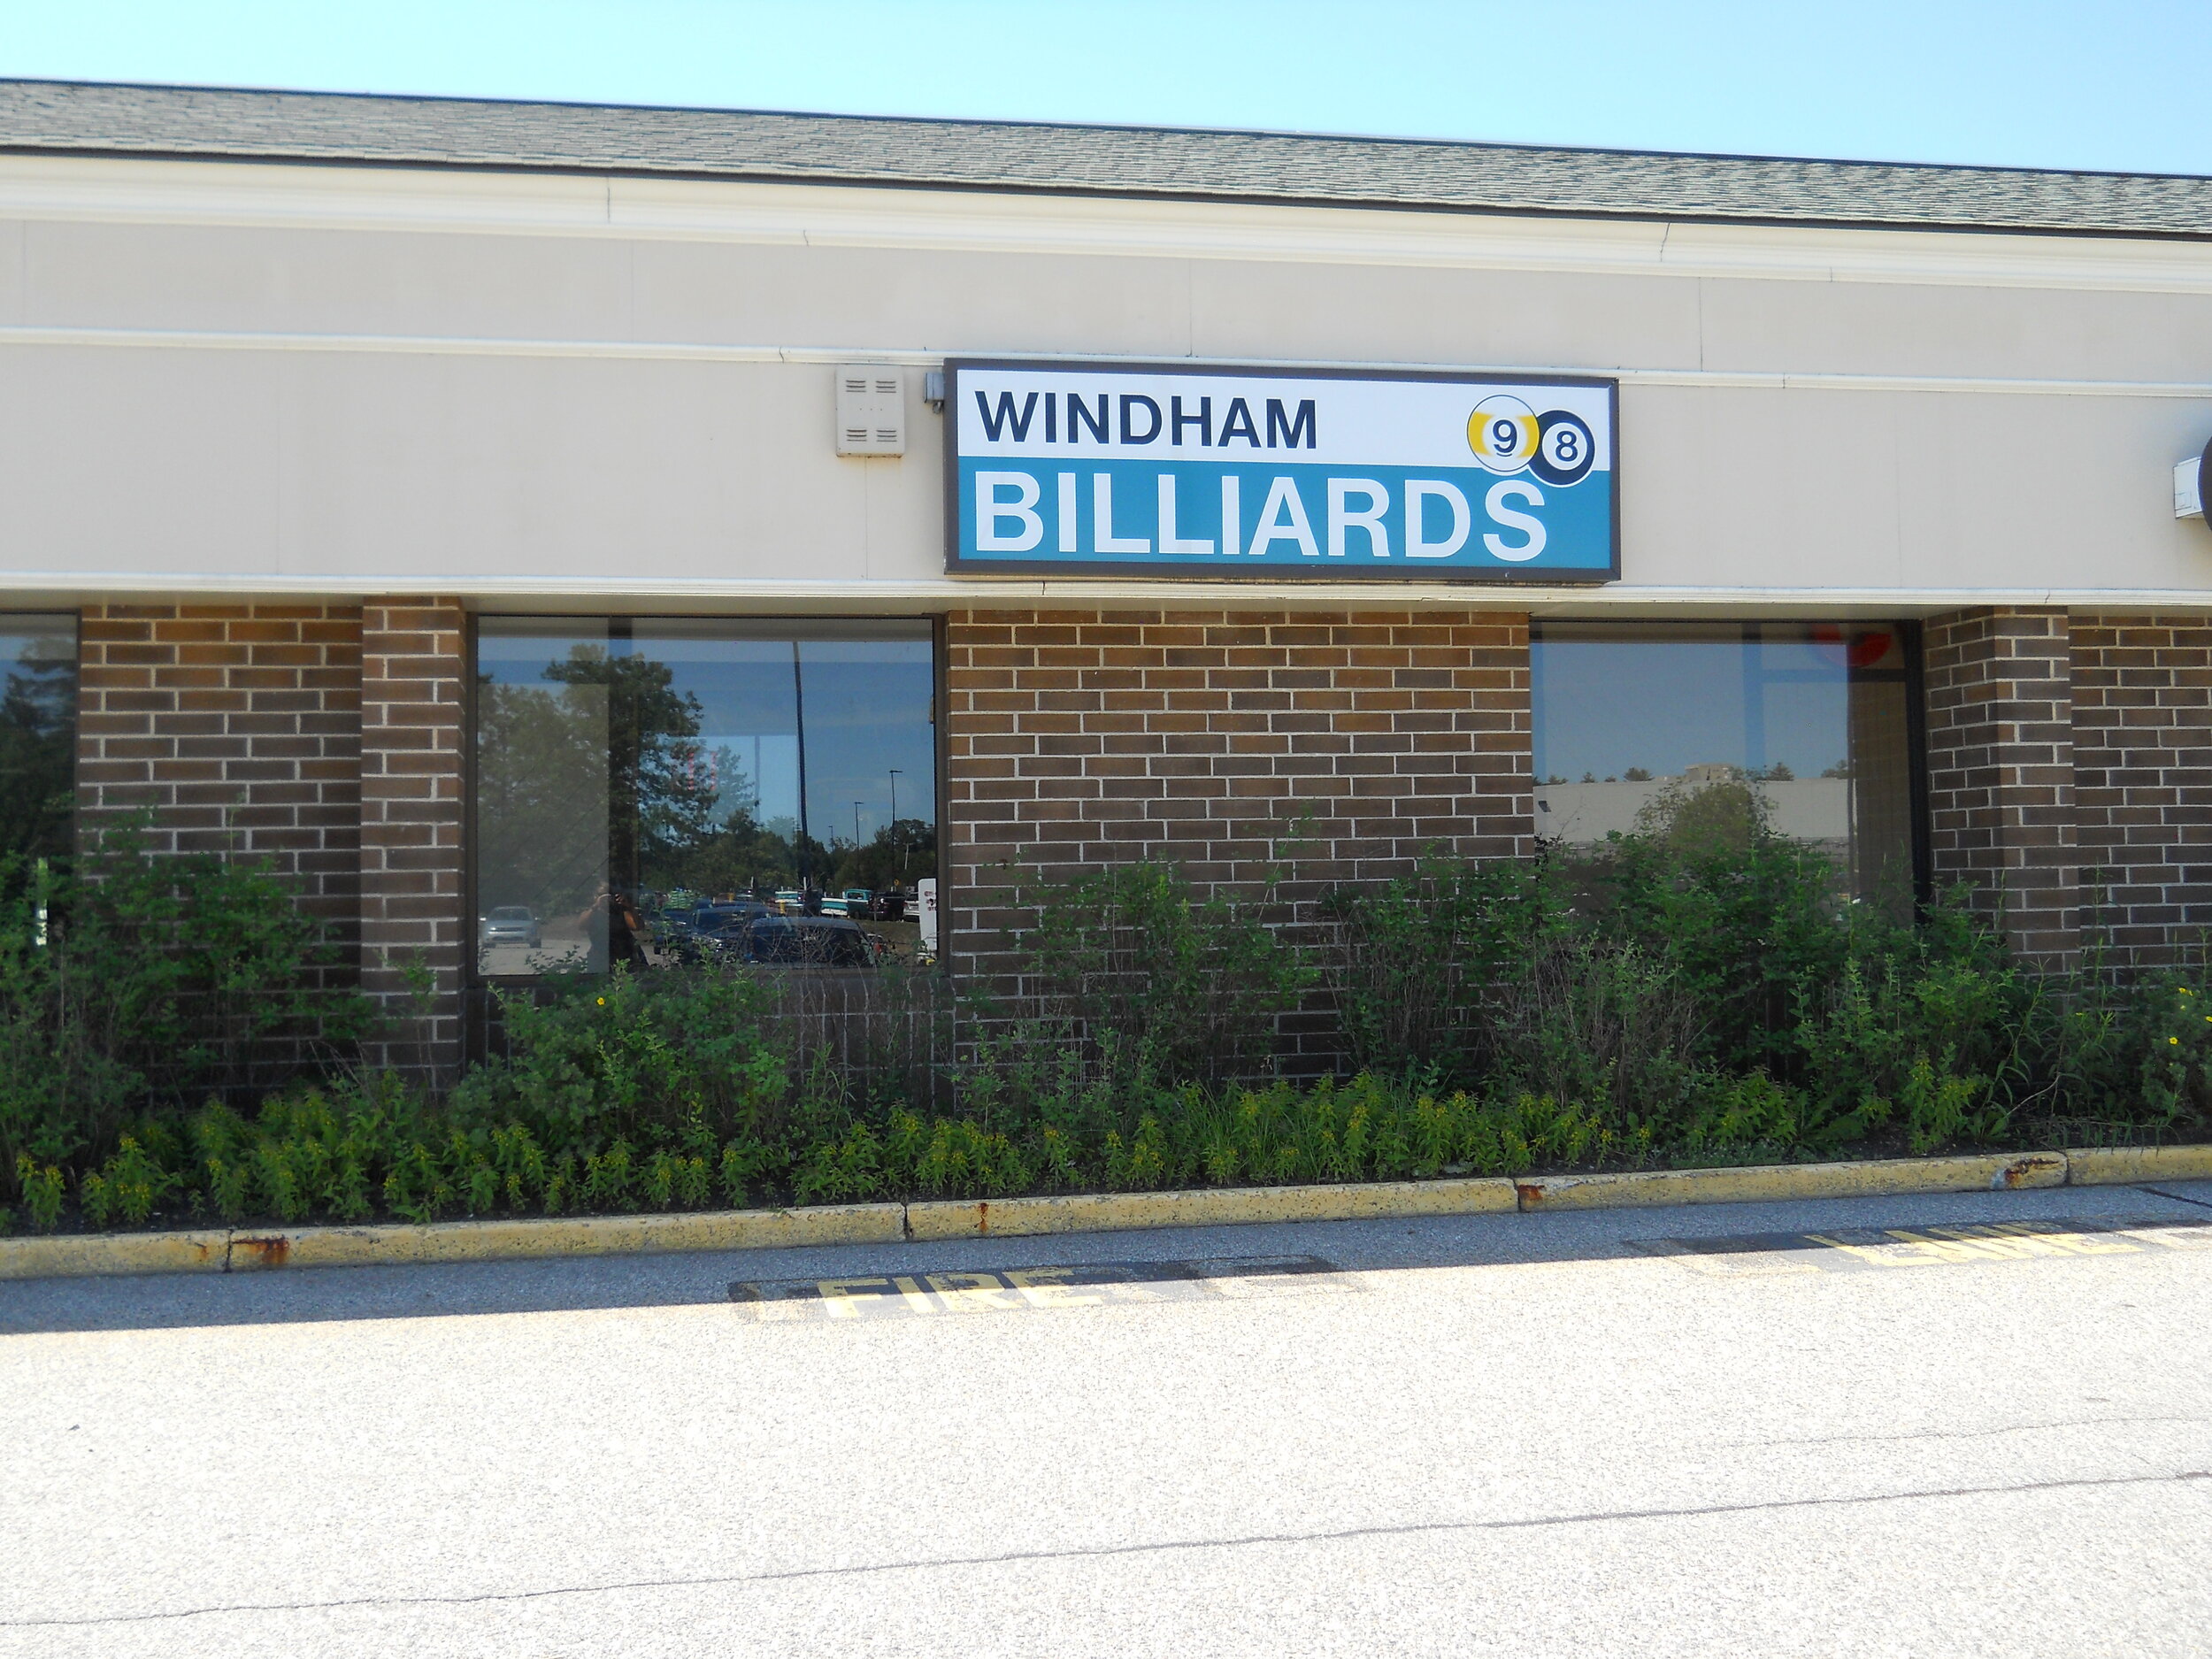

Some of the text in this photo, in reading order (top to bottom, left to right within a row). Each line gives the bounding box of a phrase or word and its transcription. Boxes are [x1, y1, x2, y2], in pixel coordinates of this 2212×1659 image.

[974, 390, 1317, 450] WINDHAM
[1492, 419, 1578, 462] 9 8
[975, 471, 1548, 562] BILLIARDS
[816, 1267, 1104, 1318] FIRE
